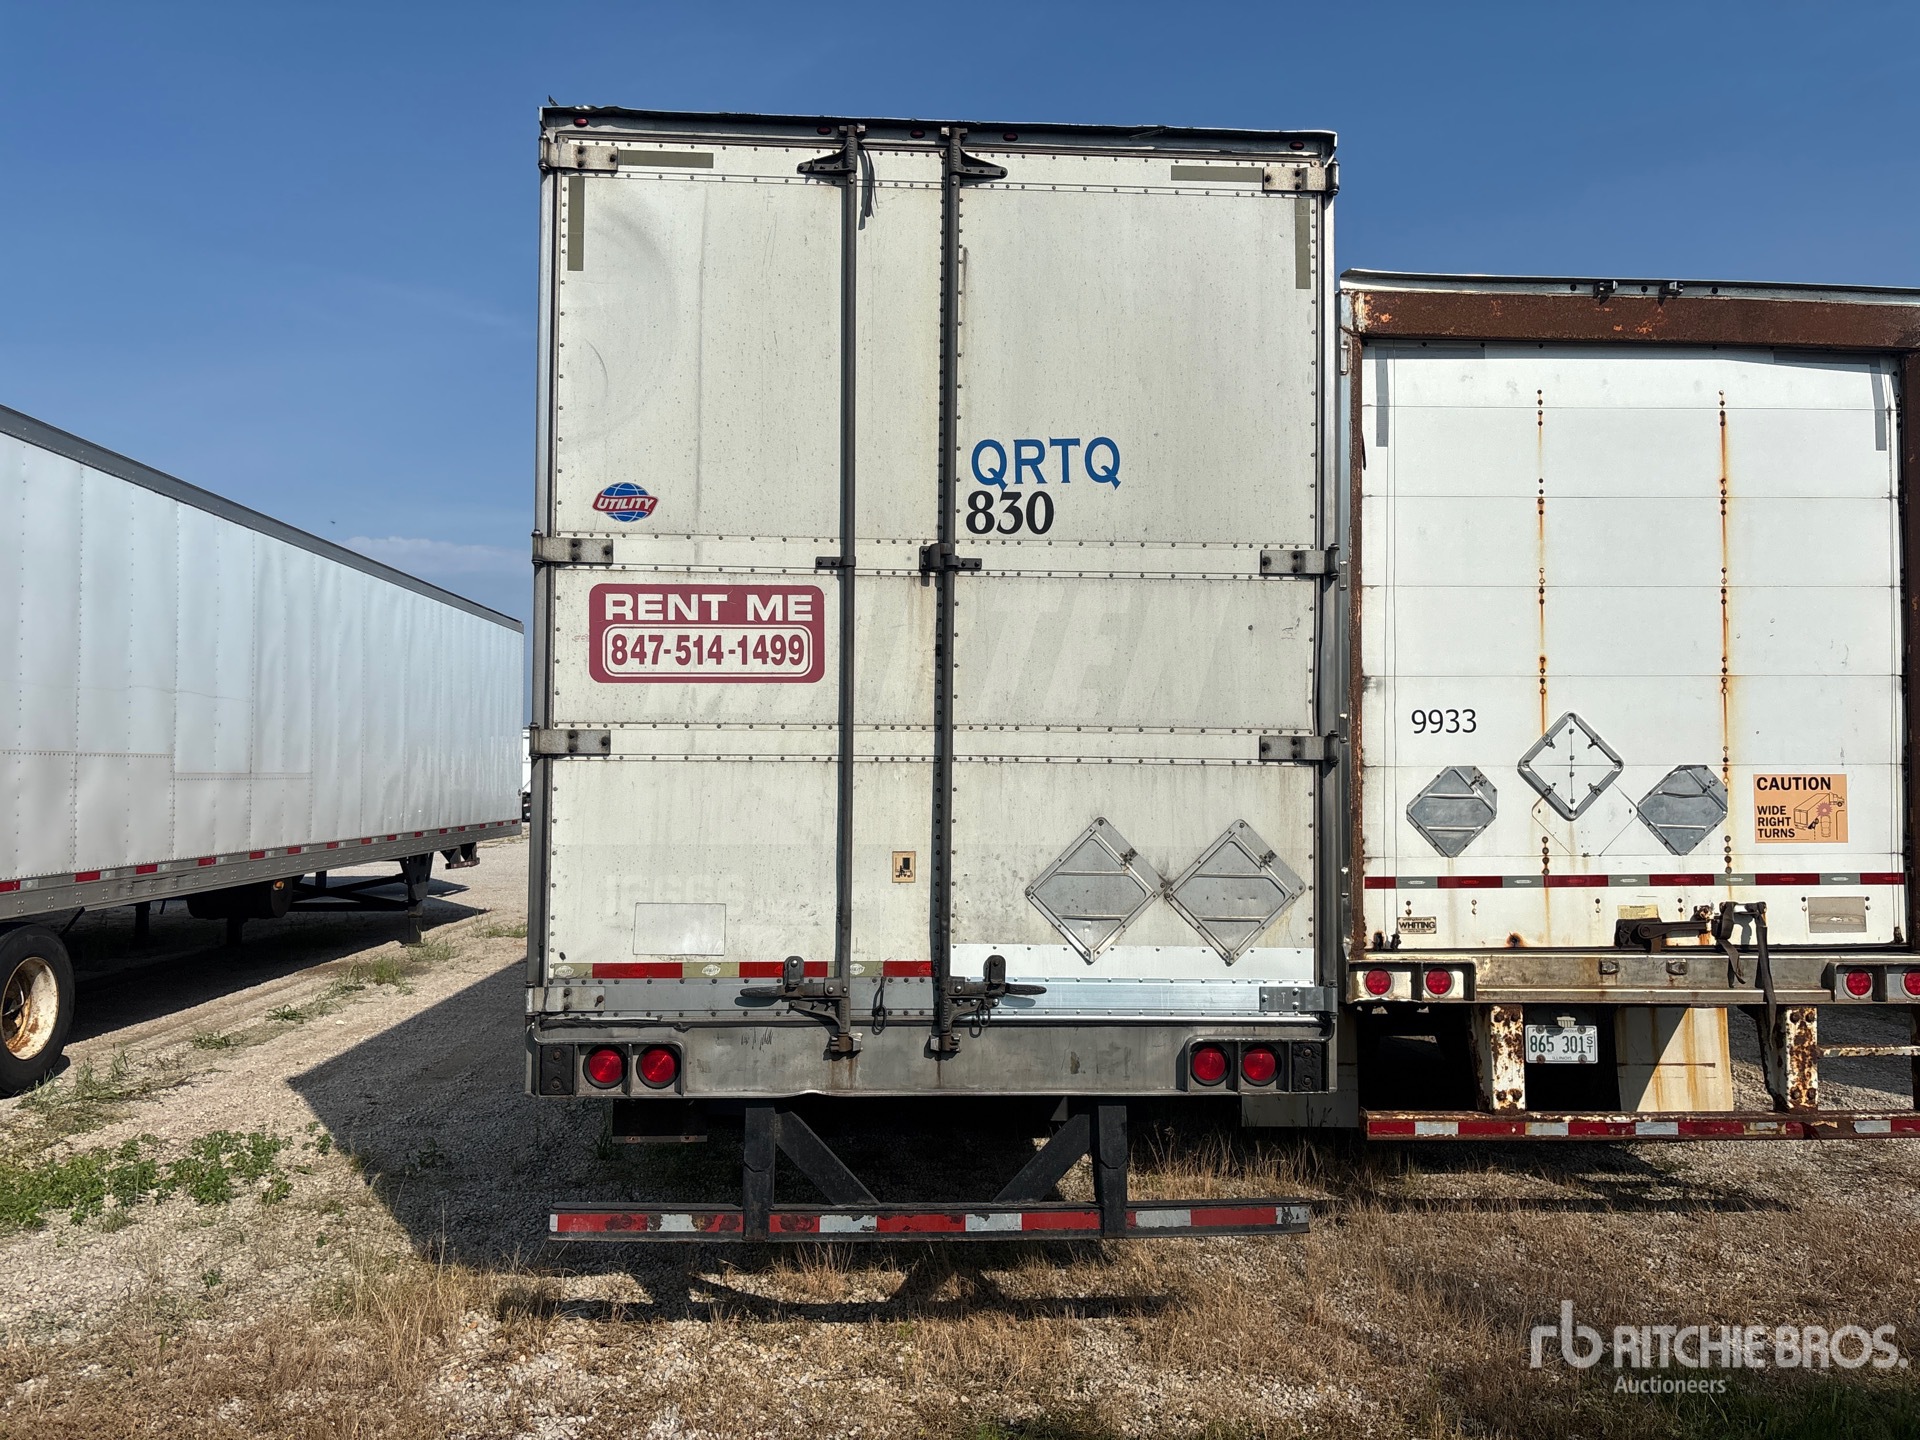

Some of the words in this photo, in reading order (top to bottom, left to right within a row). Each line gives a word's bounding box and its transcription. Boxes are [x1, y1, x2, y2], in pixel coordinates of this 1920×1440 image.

[972, 436, 1121, 491] QRTQ
[597, 497, 655, 510] UTILITY
[966, 490, 1055, 535] 830
[605, 593, 728, 621] RENT
[746, 594, 813, 622] ME
[611, 634, 805, 666] 847-514-1499
[1411, 708, 1477, 734] 9933
[1756, 776, 1831, 791] CAUTION
[1757, 805, 1787, 815] WIDE
[1757, 816, 1791, 827] RIGHT
[1757, 828, 1795, 838] TURNS
[1398, 921, 1436, 929] WHITING
[1529, 1034, 1555, 1053] 865
[1561, 1035, 1586, 1053] 301
